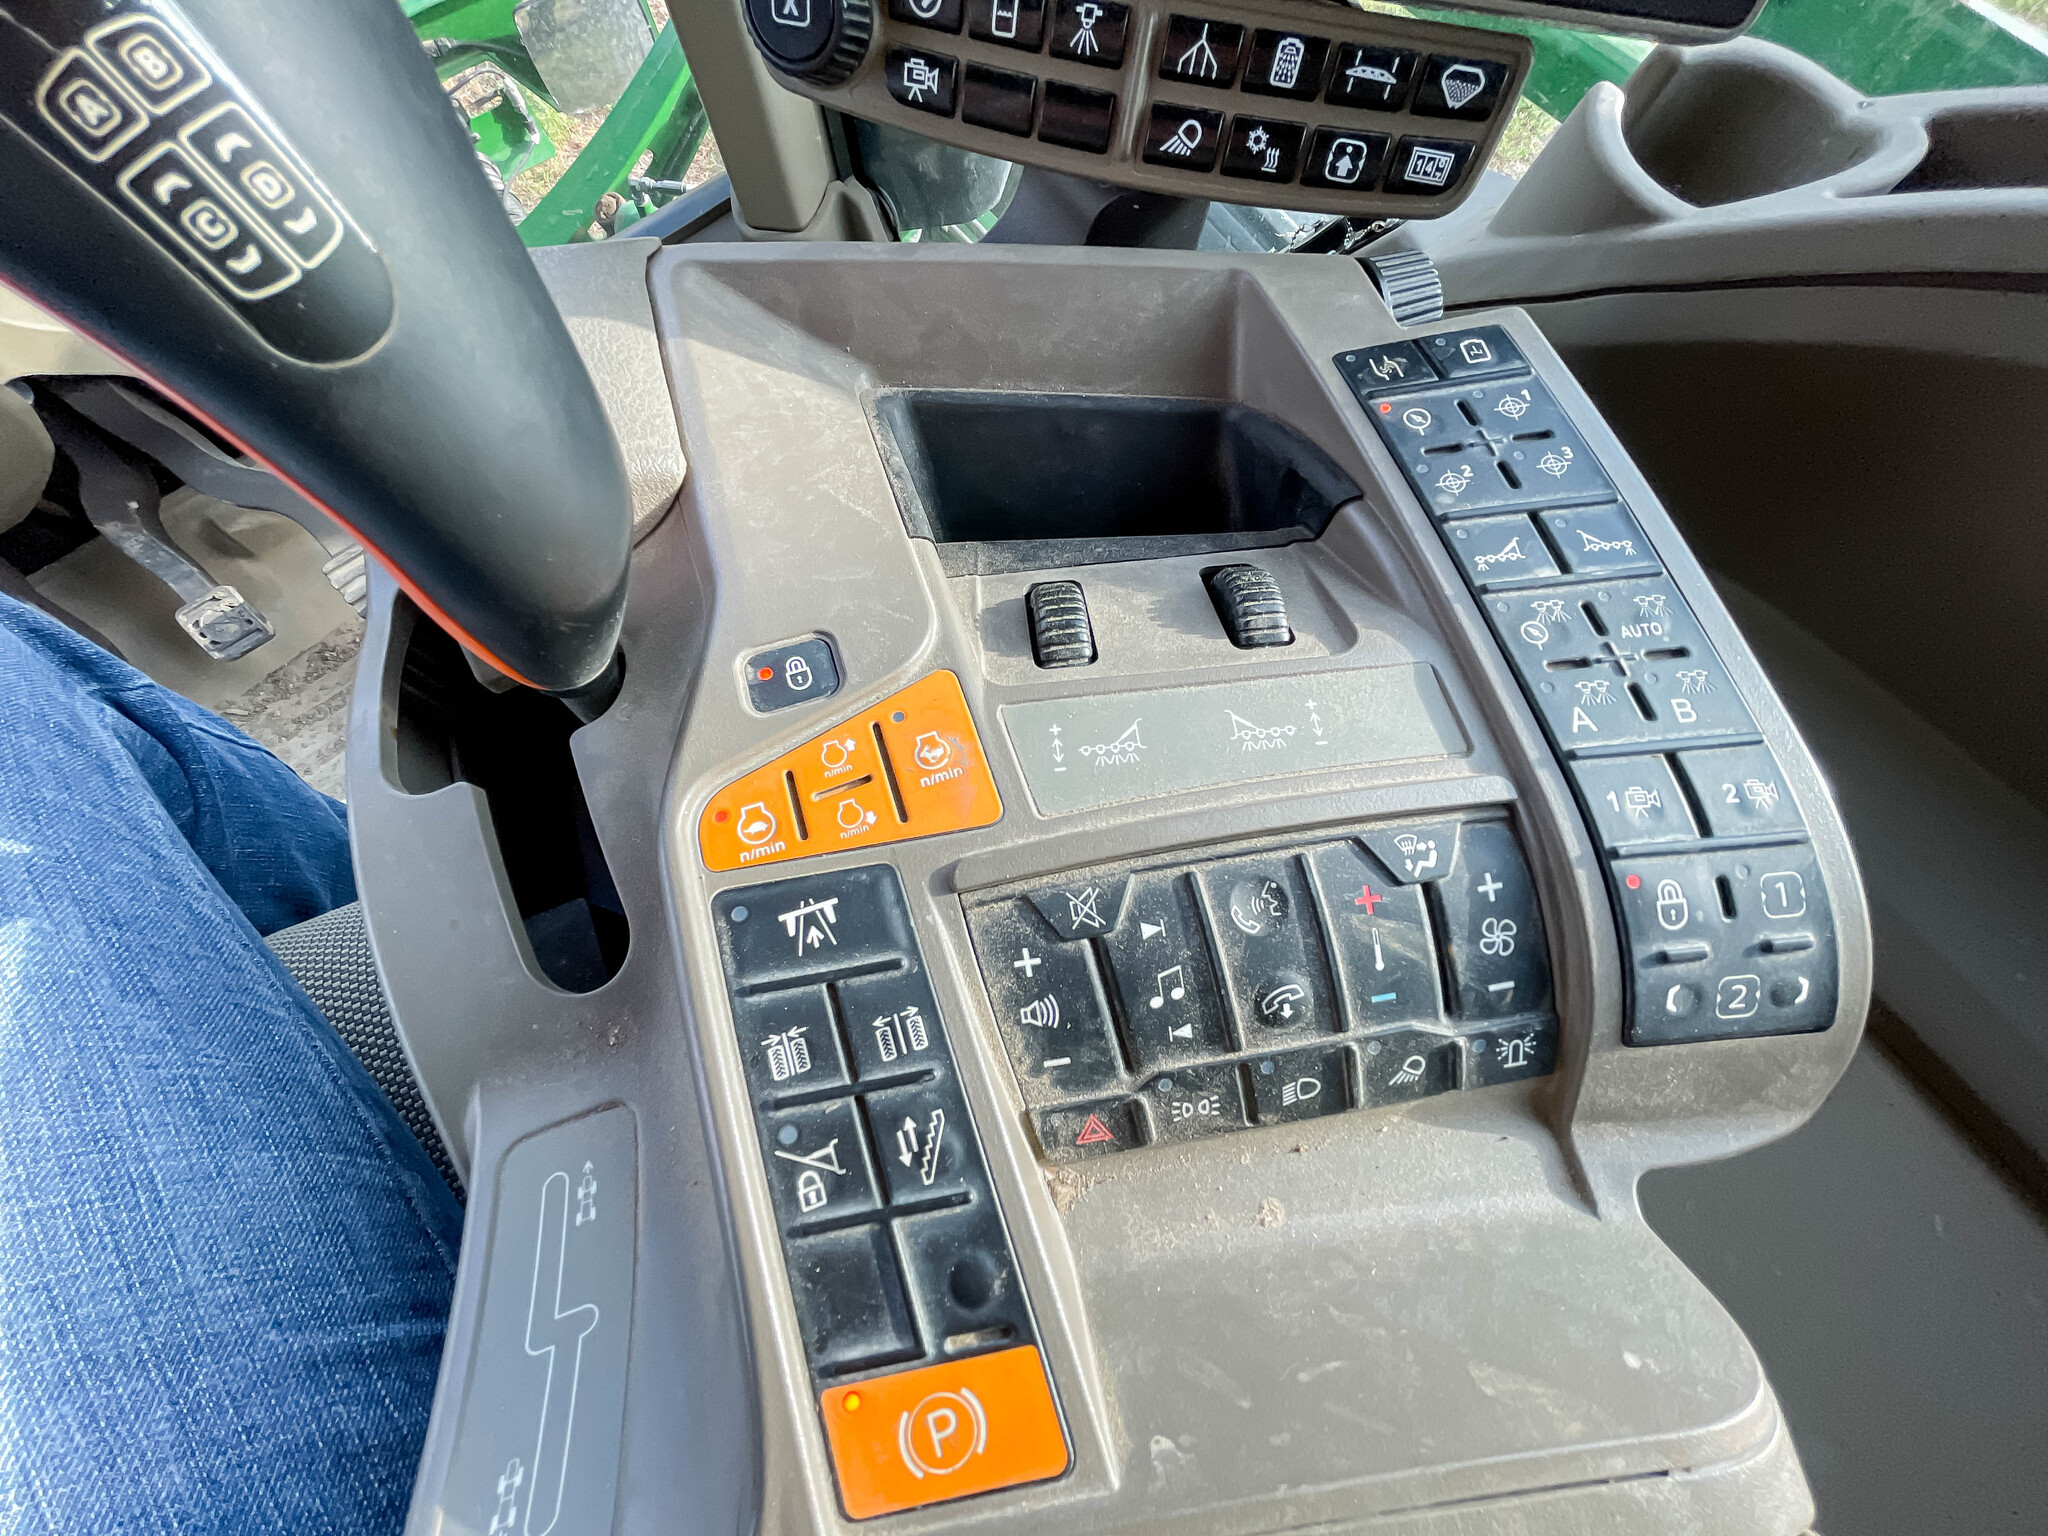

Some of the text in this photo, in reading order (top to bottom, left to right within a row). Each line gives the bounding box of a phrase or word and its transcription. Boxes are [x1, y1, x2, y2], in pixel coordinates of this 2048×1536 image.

[132, 47, 168, 79] B
[75, 93, 109, 126] A
[252, 172, 281, 200] D
[195, 211, 226, 237] C
[1520, 389, 1532, 401] 1
[1560, 446, 1574, 459] 3
[1460, 465, 1474, 478] 2
[1621, 622, 1663, 639] AUTO
[1571, 707, 1598, 733] A
[1670, 699, 1697, 723] B
[824, 763, 853, 778] n/min
[919, 765, 964, 788] n/min
[1606, 791, 1620, 812] 1
[1721, 783, 1740, 804] 2
[840, 824, 871, 840] n/min
[739, 840, 787, 863] n/min
[1775, 881, 1788, 908] 1
[1728, 984, 1747, 1010] 2
[926, 1407, 957, 1459] P
